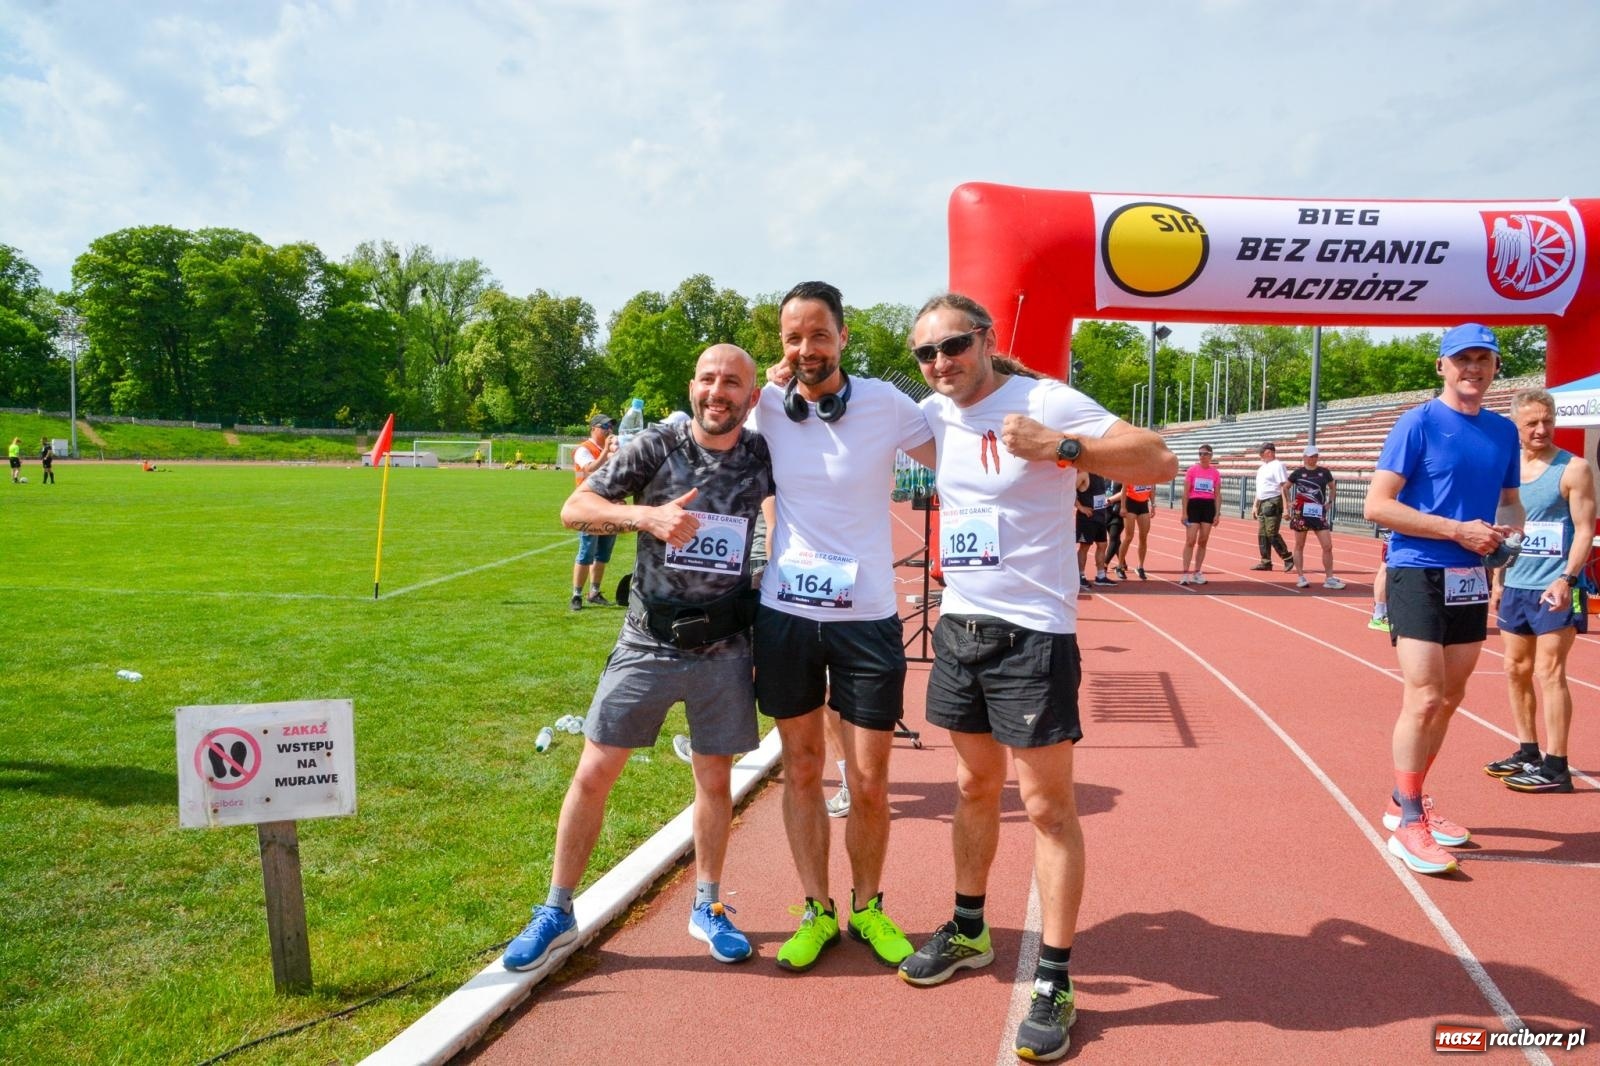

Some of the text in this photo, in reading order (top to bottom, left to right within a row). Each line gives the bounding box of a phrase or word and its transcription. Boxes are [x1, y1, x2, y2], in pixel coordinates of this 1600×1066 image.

[1151, 213, 1206, 234] SIR
[1298, 208, 1380, 226] BIEG
[1236, 237, 1450, 265] BEZ GRANIC
[1246, 272, 1429, 302] RACIBÓRZ
[685, 535, 728, 558] 266
[949, 532, 978, 553] 182
[1523, 535, 1547, 548] 241
[827, 554, 854, 564] GRANIC
[795, 573, 833, 595] 164
[1459, 578, 1476, 593] 217
[297, 758, 317, 769] NA
